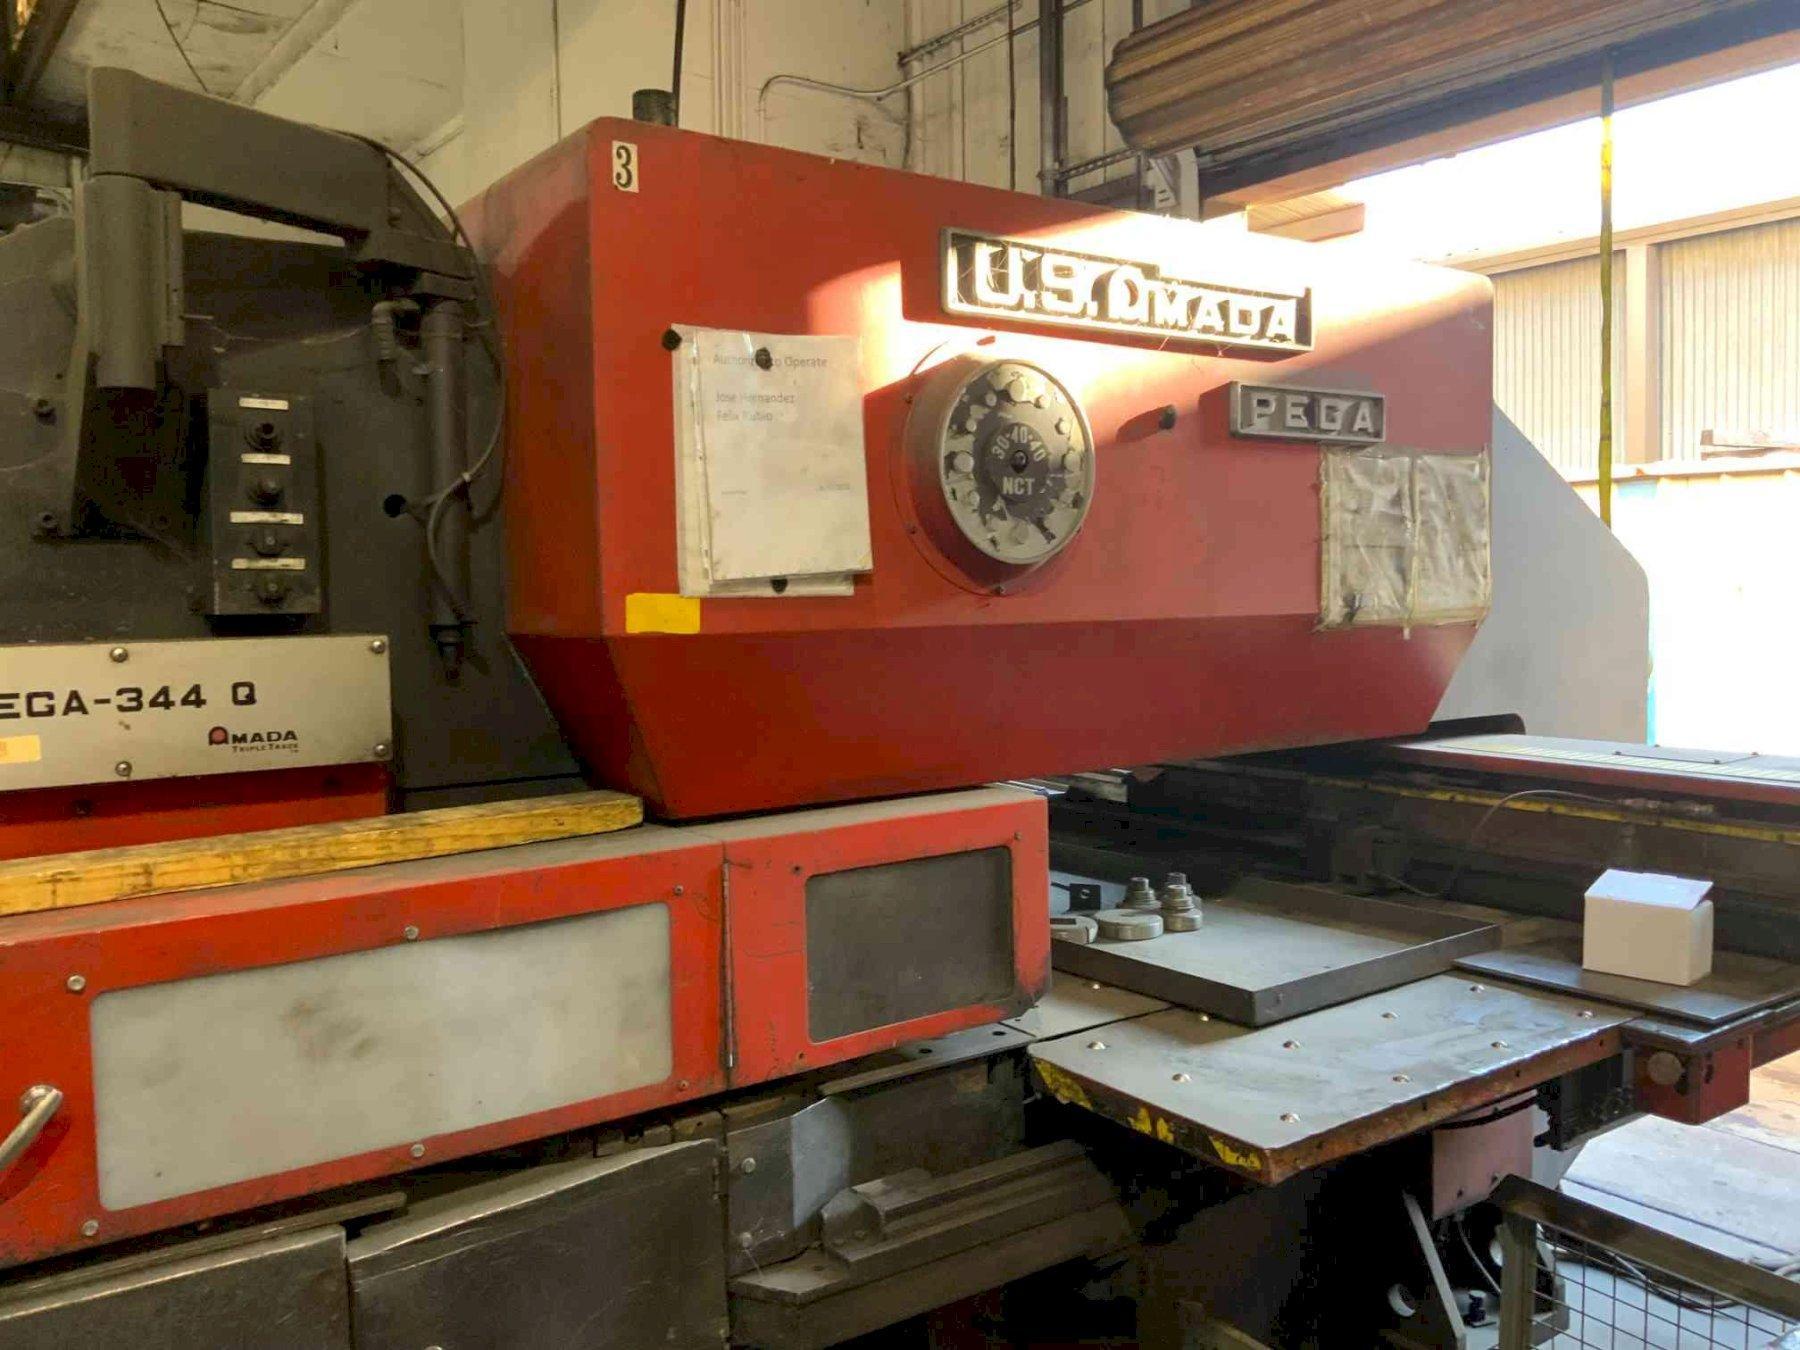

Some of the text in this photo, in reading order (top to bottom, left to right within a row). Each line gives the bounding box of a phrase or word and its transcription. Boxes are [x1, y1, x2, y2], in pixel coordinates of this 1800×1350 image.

[615, 144, 633, 189] 3
[973, 241, 1298, 345] U.S. AMADA
[784, 356, 828, 370] Operate
[1250, 398, 1377, 434] PEGA
[1002, 475, 1036, 496] NCT
[231, 681, 257, 706] Q
